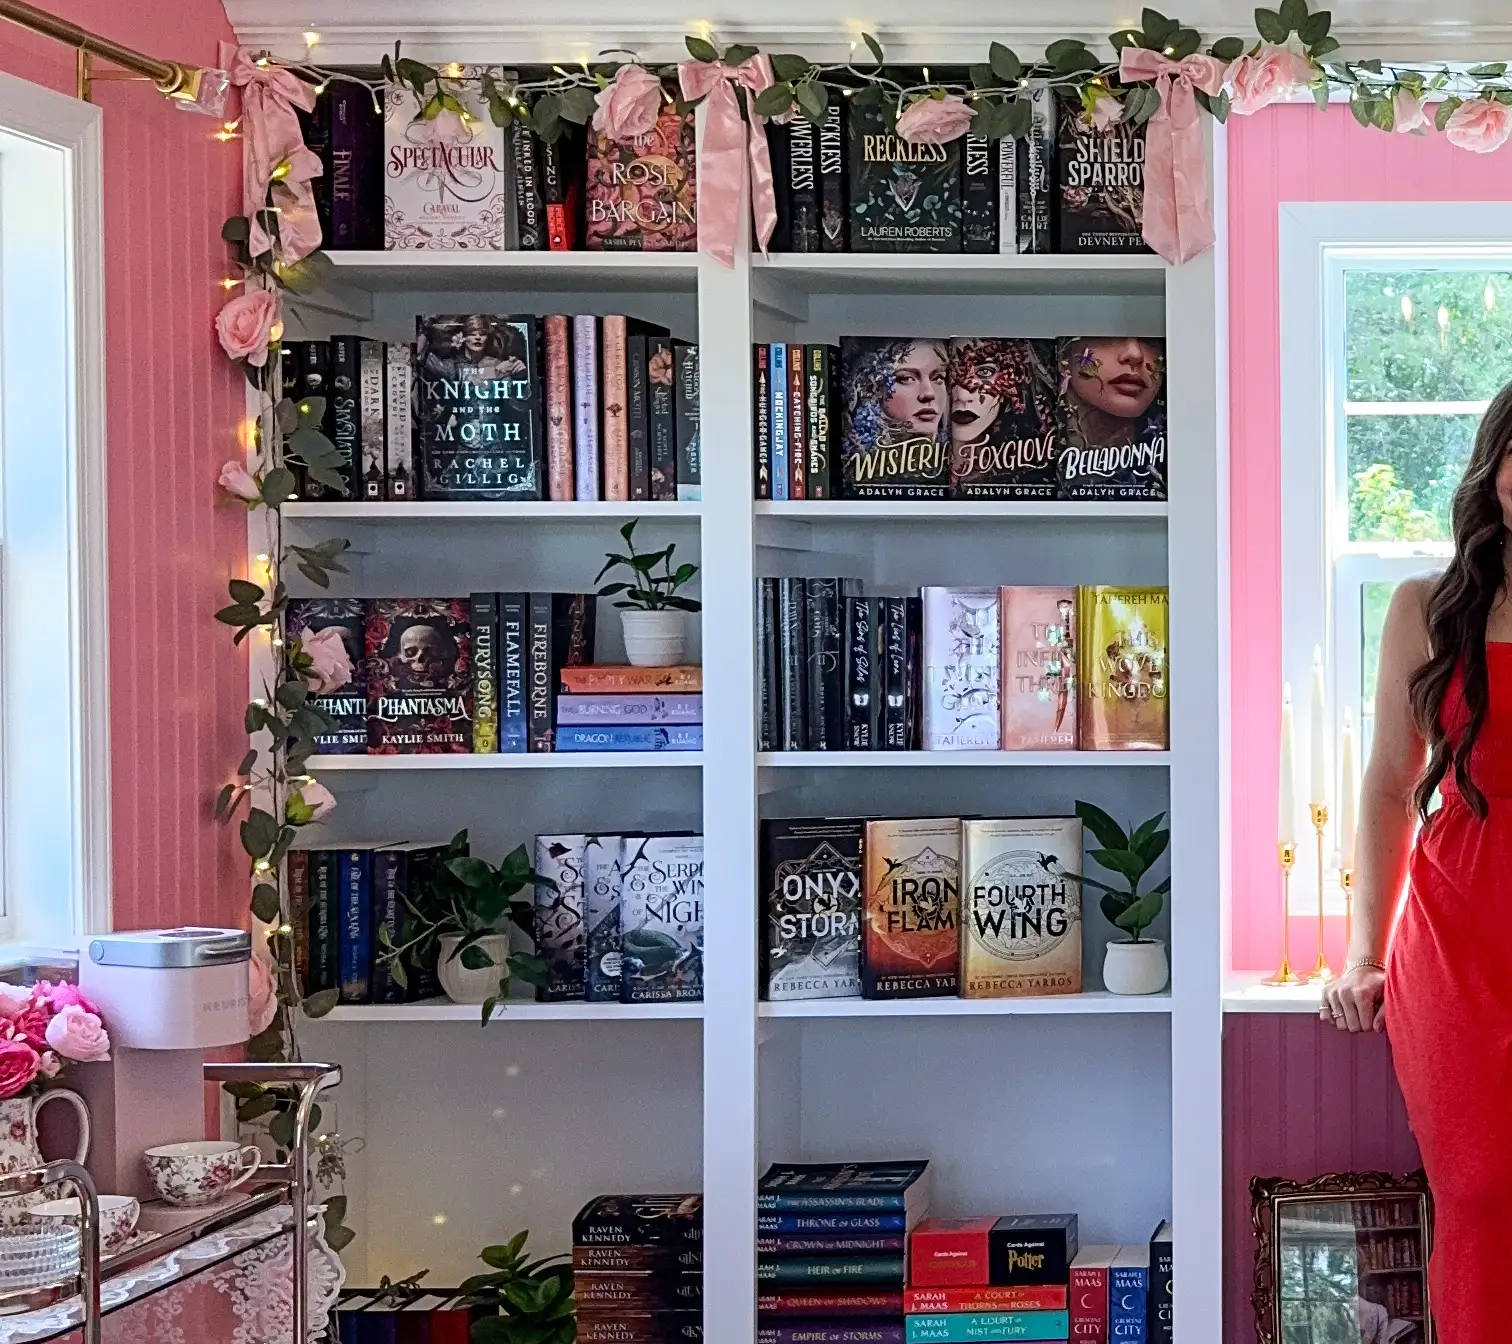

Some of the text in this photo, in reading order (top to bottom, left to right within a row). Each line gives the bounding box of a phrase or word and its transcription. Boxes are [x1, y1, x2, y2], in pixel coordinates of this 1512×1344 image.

[863, 134, 948, 163] RECKLESS
[1076, 135, 1145, 163] SHIELD
[387, 142, 505, 180] SPECTACULAR
[1000, 140, 1014, 190] POWERFUL
[332, 149, 353, 202] FINALE
[612, 162, 675, 187] ROSE
[522, 139, 536, 226] INKED IN BLOOD
[591, 199, 697, 226] BARGAIN
[861, 226, 953, 238] LAUREN ROBERTS
[1077, 234, 1126, 246] DEVNEY
[426, 377, 529, 400] KNIGHT
[370, 376, 380, 417] DARK
[398, 370, 407, 422] TWISTED
[793, 391, 802, 439] CATCHING
[774, 391, 784, 457] MOCKINGJAY
[435, 422, 521, 441] MOTH
[758, 435, 768, 464] GAMES
[434, 458, 525, 469] RACHEL
[1059, 436, 1166, 480] BELLADONNA
[859, 487, 945, 498] ADALYN GRACE
[966, 487, 1053, 497] ADALYN GRACE
[1071, 487, 1157, 497] ADALYN GRACE
[473, 624, 492, 718] FURYSONG
[506, 621, 520, 718] FLAMEFALL
[532, 623, 548, 719] FIREBORNE
[382, 734, 424, 745] KAYLIE
[573, 733, 613, 743] DRAGON
[892, 875, 959, 906] IRON
[973, 883, 1066, 908] FOURTH
[973, 908, 1068, 939] WING
[774, 978, 829, 992] REBECCA
[877, 978, 931, 991] REBECCA
[969, 977, 1073, 991] REBECCA YARROS
[796, 1218, 881, 1227] THRONE GLASS
[581, 1234, 632, 1243] KENNEDY
[786, 1239, 886, 1249] CROWN MIDNIGHT
[1007, 1249, 1045, 1274] Potter
[806, 1264, 863, 1275] HEIR FIRE
[1074, 1278, 1103, 1288] MAAS
[1115, 1279, 1143, 1288] MAAS
[913, 1292, 947, 1301] SARAH
[919, 1302, 949, 1311] MAAS
[913, 1319, 947, 1327] SARAH
[1073, 1323, 1102, 1335] CITY
[1114, 1324, 1141, 1336] CITY
[792, 1331, 883, 1341] EMPIRE STORMS
[919, 1329, 949, 1338] MAAS
